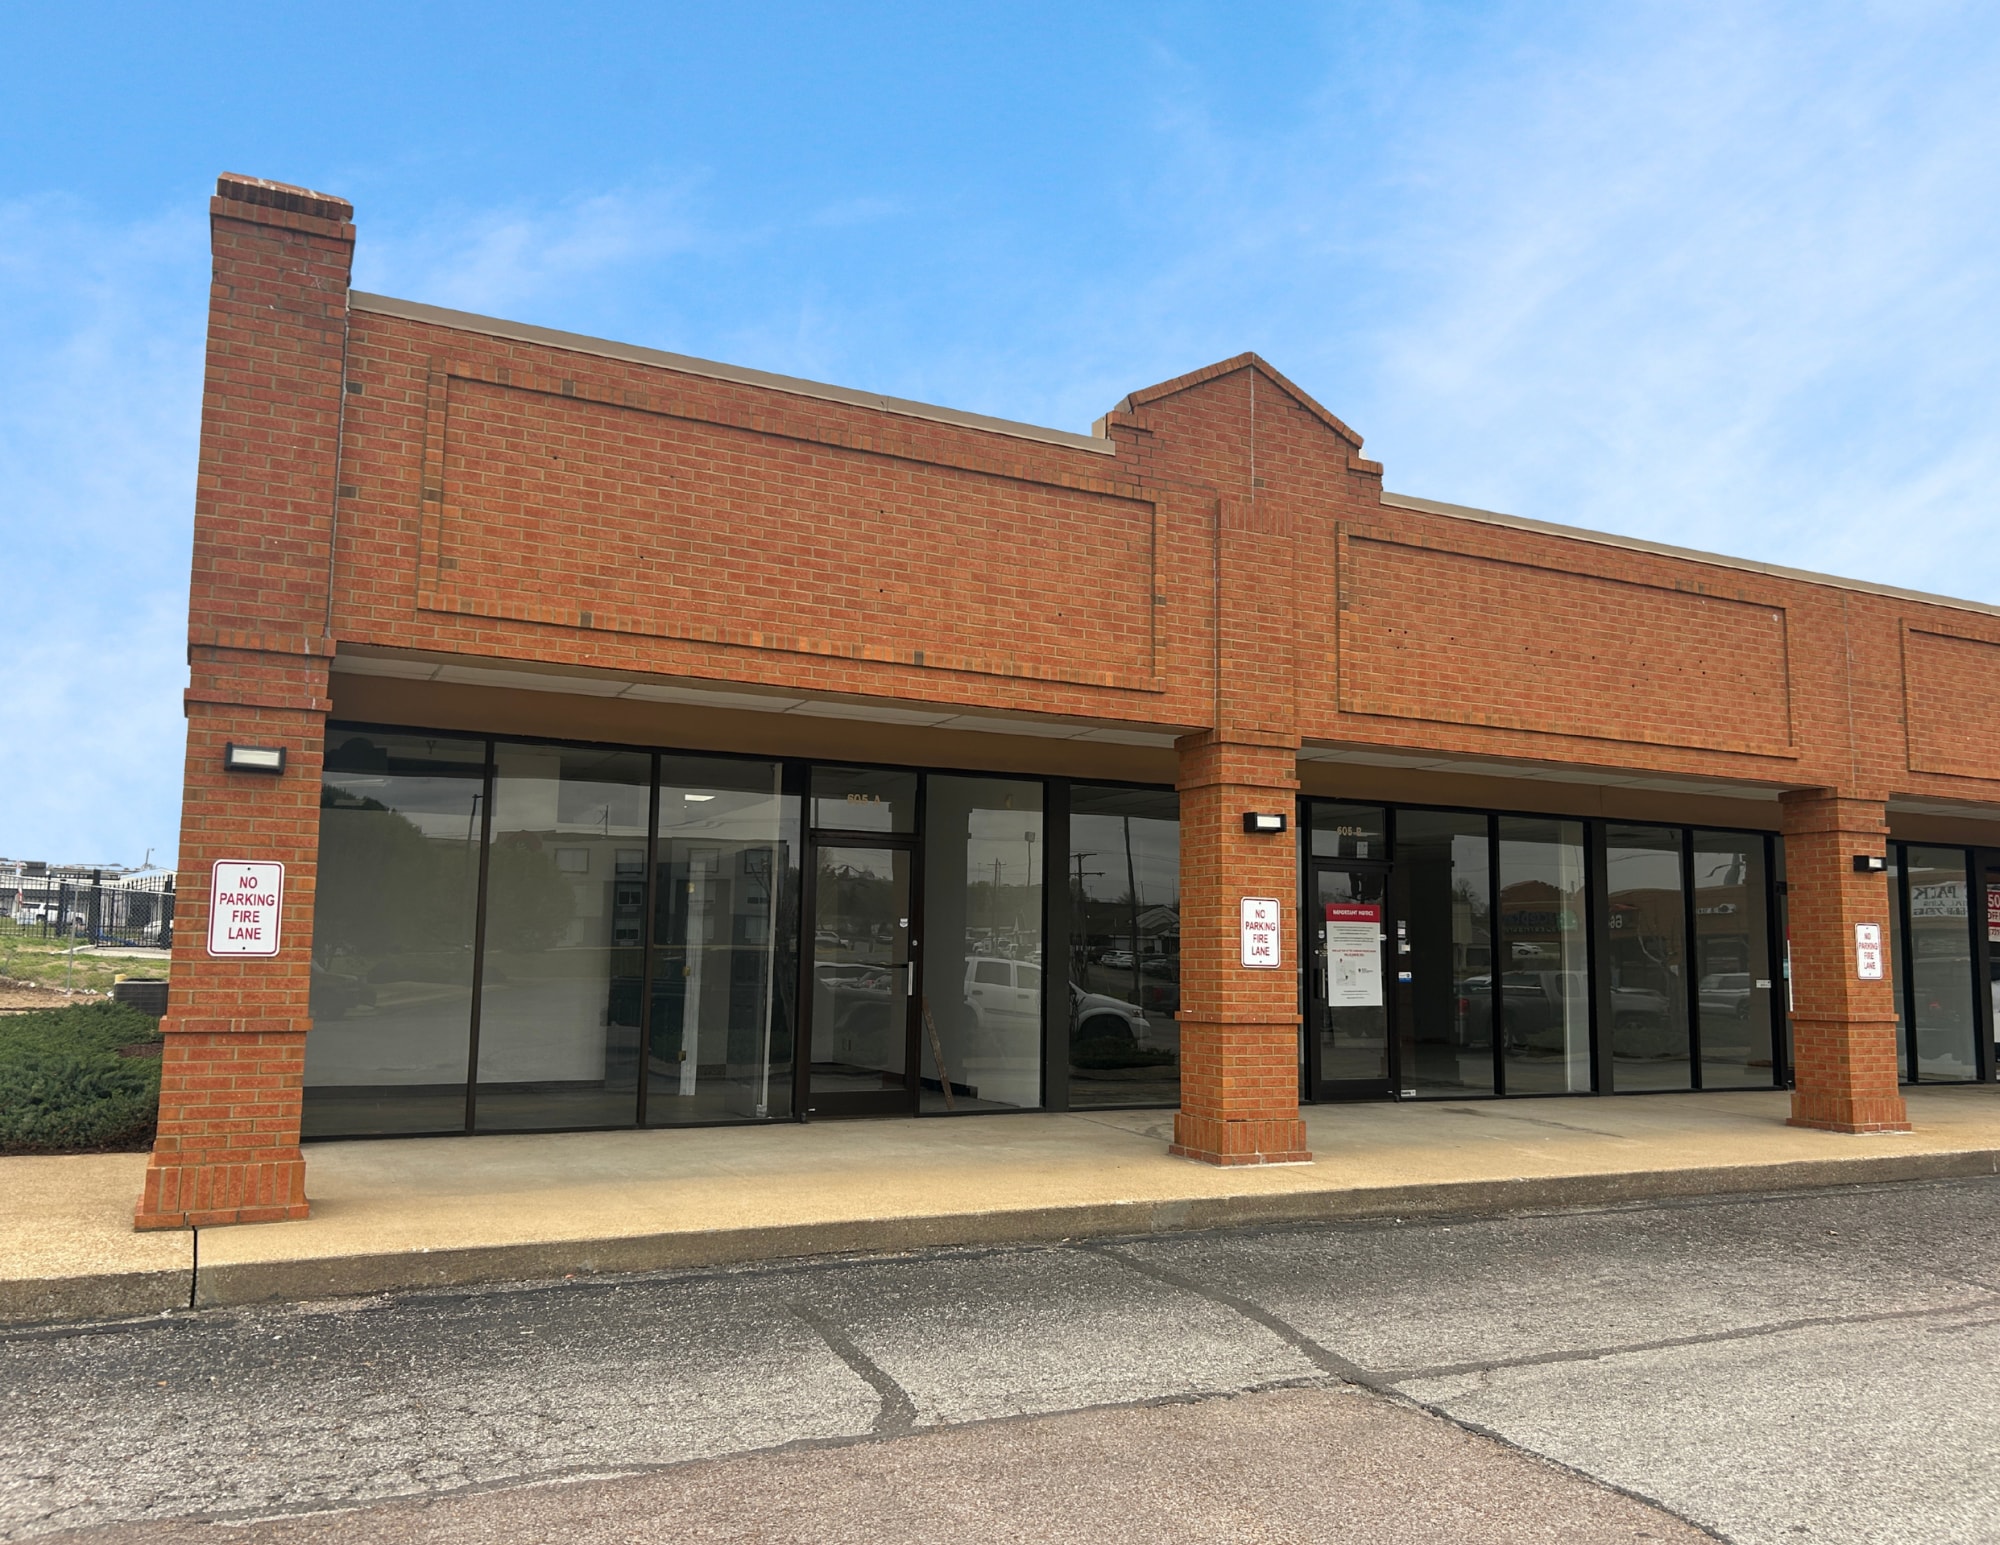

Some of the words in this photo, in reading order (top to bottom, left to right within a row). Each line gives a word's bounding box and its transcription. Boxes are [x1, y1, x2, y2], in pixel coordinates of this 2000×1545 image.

[847, 793, 868, 806] 605
[873, 794, 881, 808] A
[1336, 826, 1353, 836] 605
[239, 876, 258, 889] NO
[219, 892, 275, 907] PARKING
[232, 910, 260, 923] FIRE
[1255, 909, 1266, 919] NO
[1245, 921, 1276, 932] PARKING
[228, 927, 262, 940] LANE
[1253, 934, 1268, 944] FIRE
[1251, 945, 1270, 957] LANE
[1859, 942, 1878, 950] PARKING
[1864, 951, 1874, 960] FIRE
[1864, 961, 1876, 970] LANE
